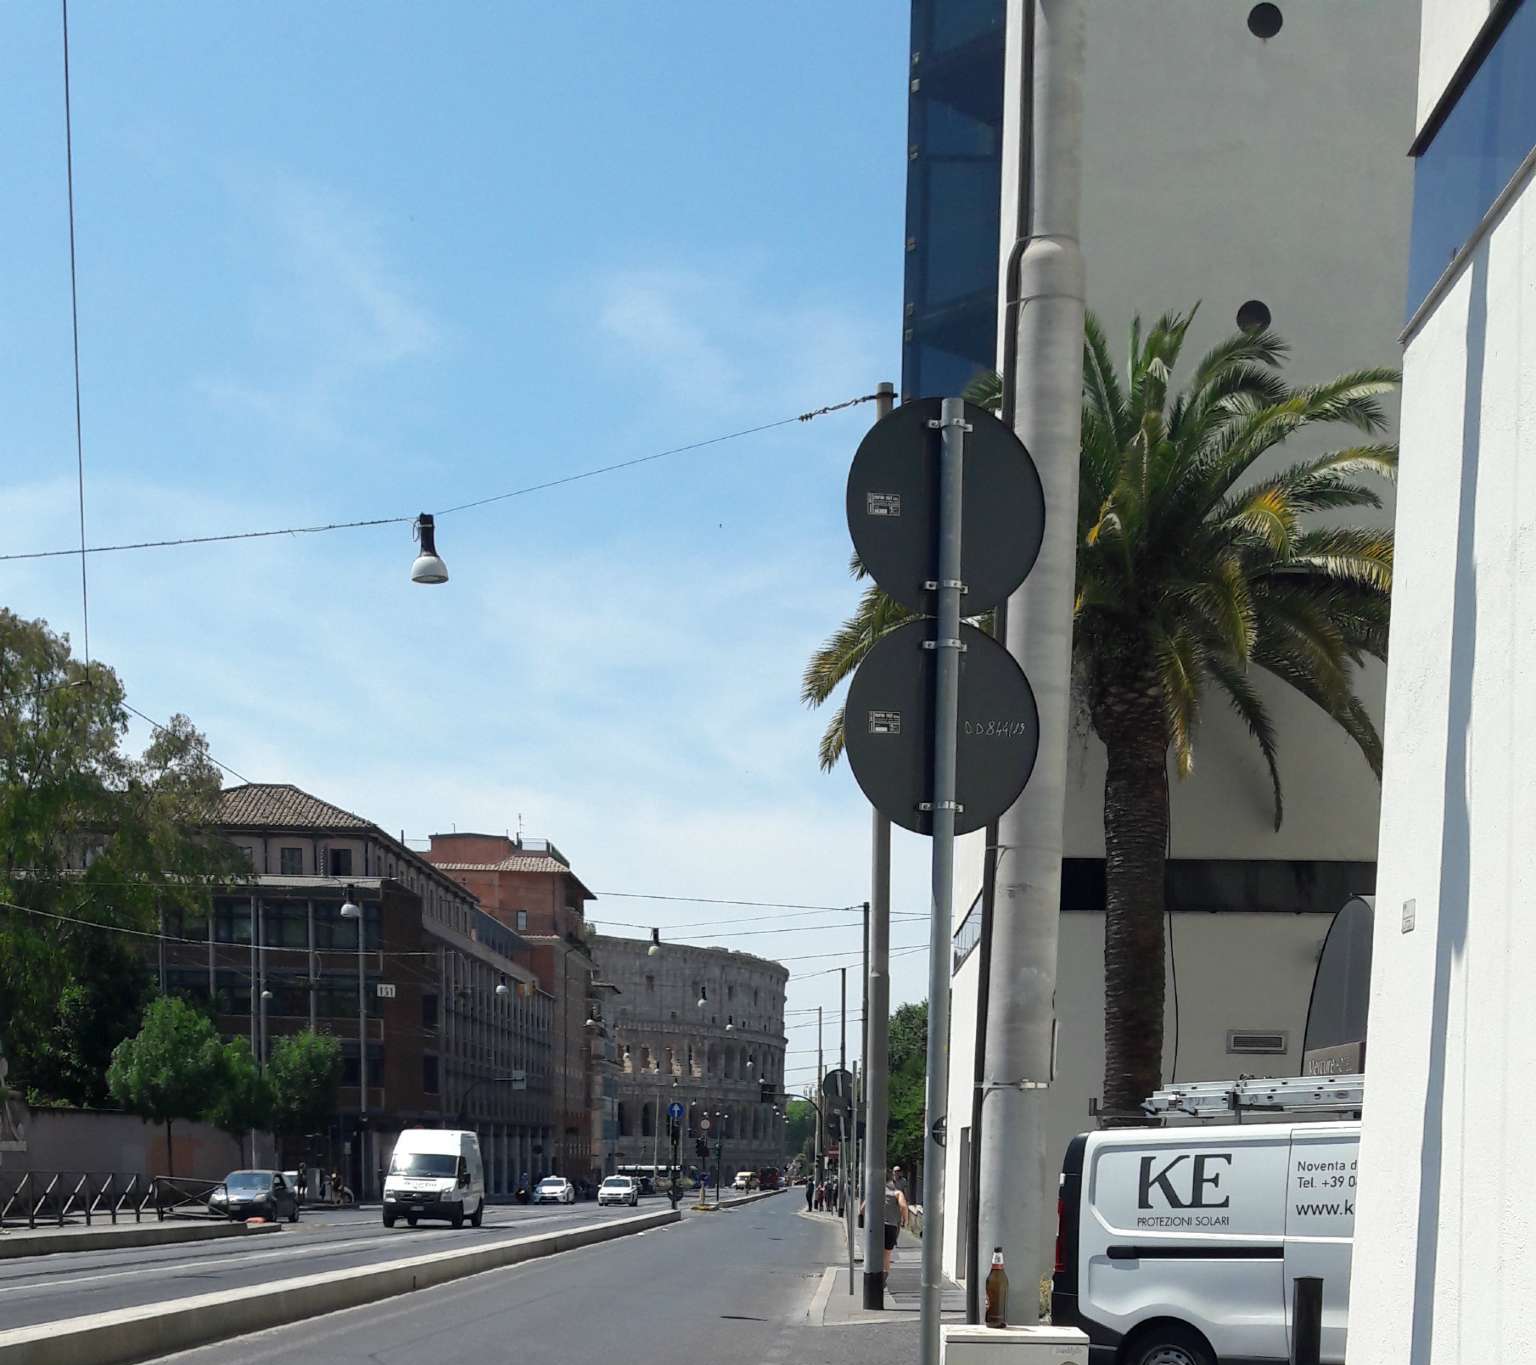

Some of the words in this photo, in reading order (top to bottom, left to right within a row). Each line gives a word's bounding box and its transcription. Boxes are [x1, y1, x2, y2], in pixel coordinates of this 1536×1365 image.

[1297, 1161, 1346, 1172] Noventa
[1138, 1154, 1232, 1209] KE
[1297, 1176, 1317, 1188] Tel.
[1321, 1176, 1345, 1188] +39
[1137, 1216, 1192, 1227] PROTEZIONI
[1195, 1216, 1230, 1226] SOLARI
